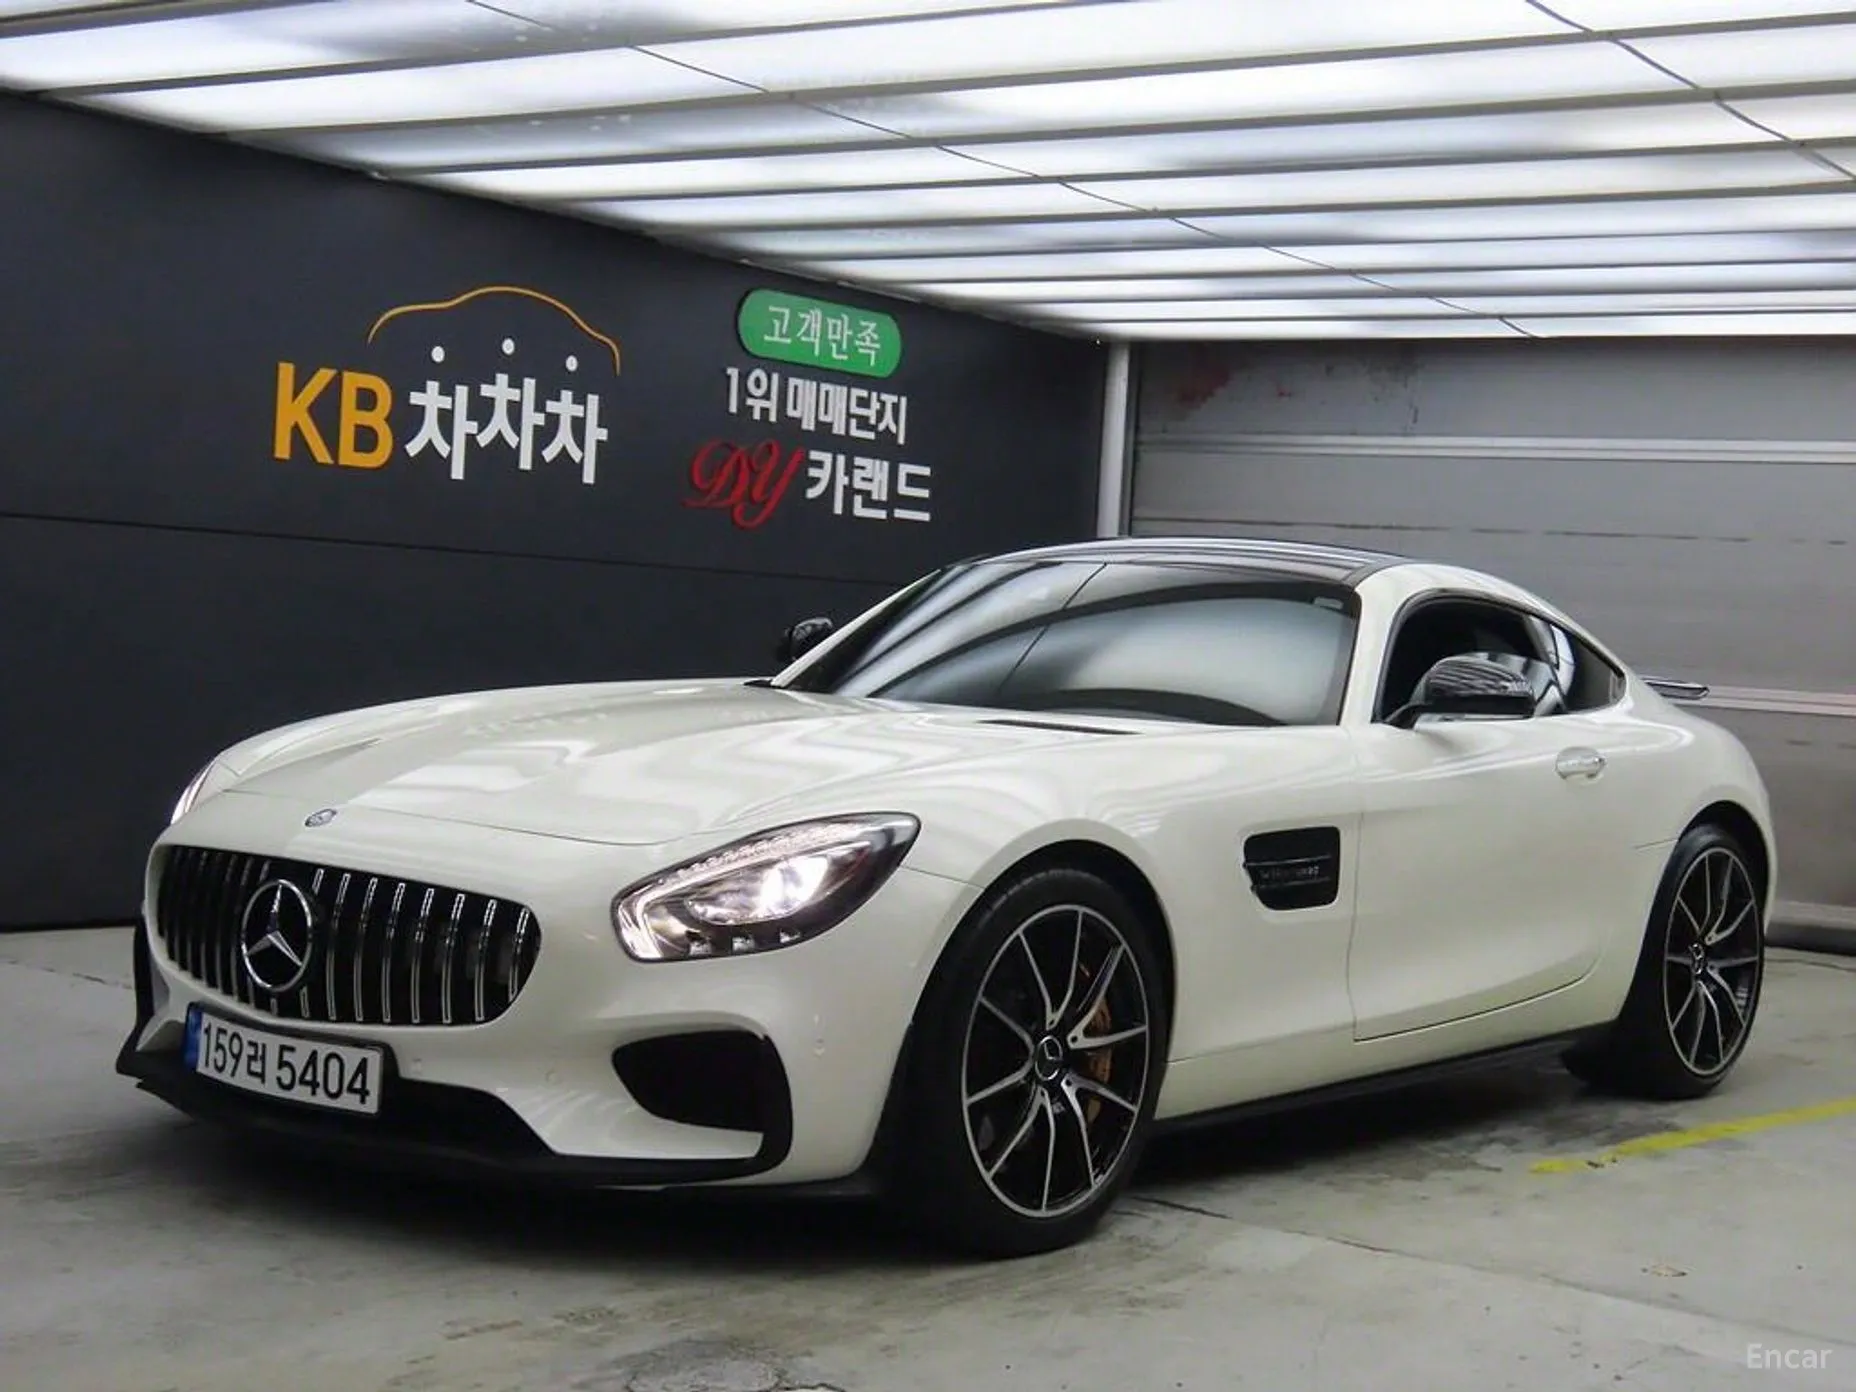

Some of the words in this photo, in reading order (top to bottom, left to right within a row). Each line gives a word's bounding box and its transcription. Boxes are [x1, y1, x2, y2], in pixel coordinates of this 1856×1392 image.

[764, 305, 881, 366] 고객만족
[274, 362, 394, 469] KB
[404, 337, 609, 484] 차차차
[726, 367, 779, 422] 1위
[786, 377, 908, 445] 매매단지
[681, 439, 805, 531] DY
[805, 450, 931, 522] 카랜드
[275, 1044, 370, 1105] 5404
